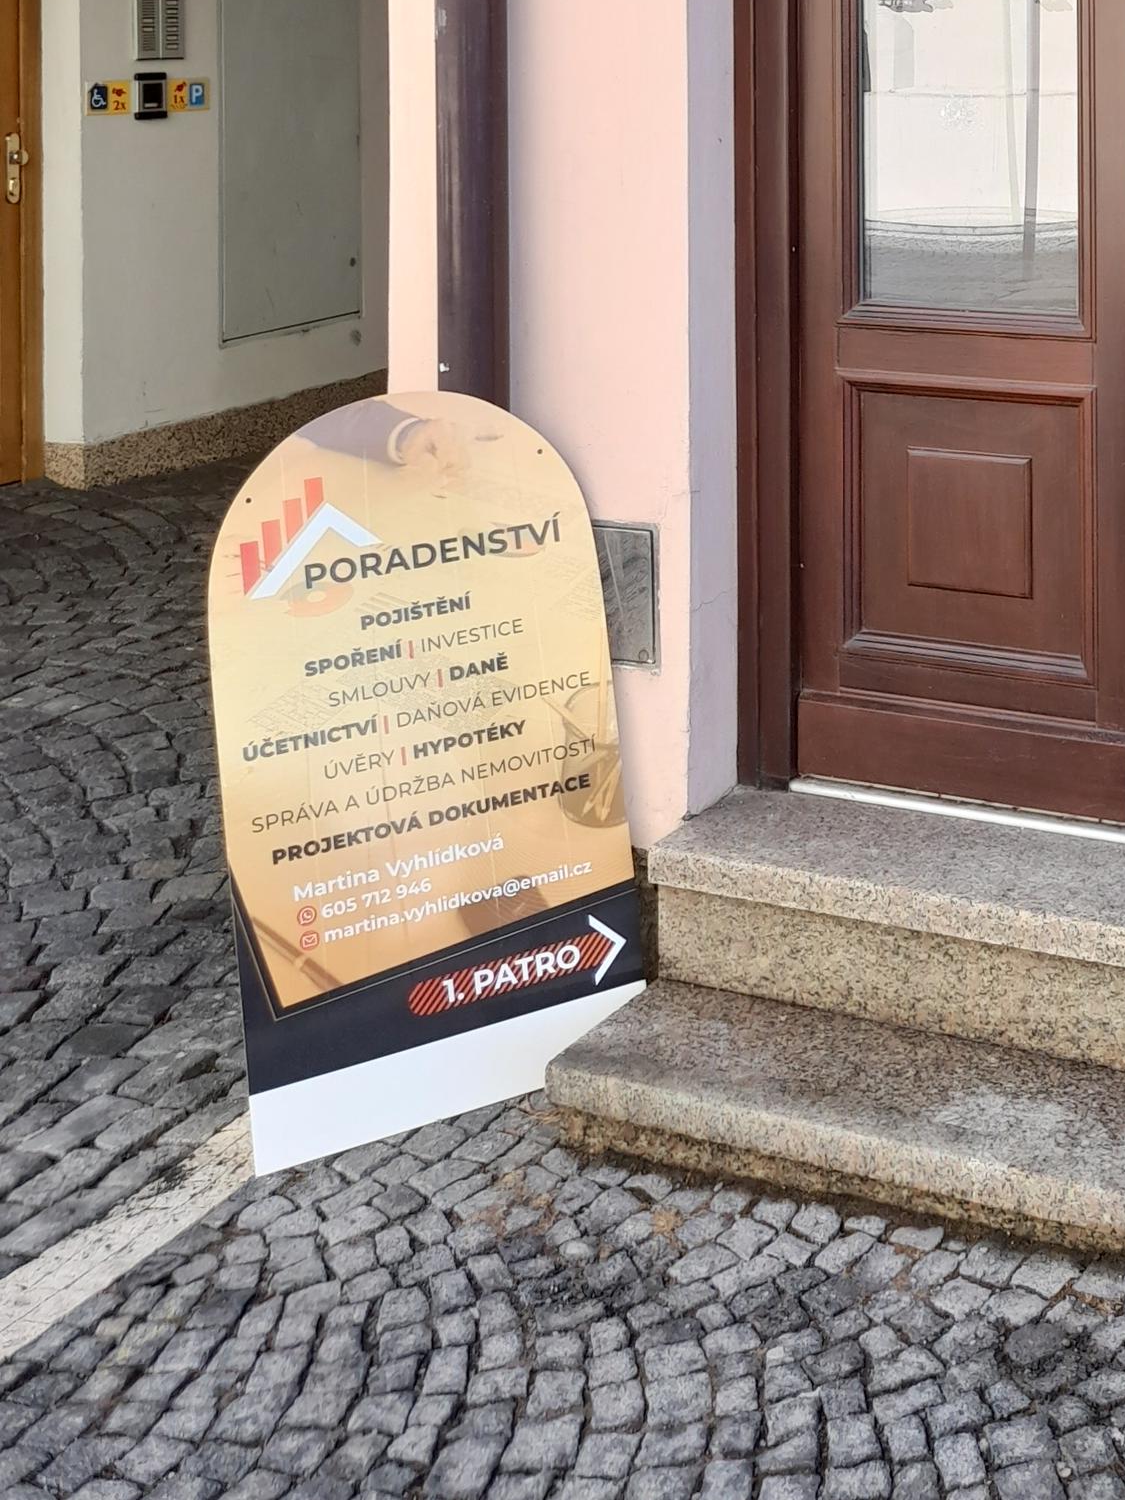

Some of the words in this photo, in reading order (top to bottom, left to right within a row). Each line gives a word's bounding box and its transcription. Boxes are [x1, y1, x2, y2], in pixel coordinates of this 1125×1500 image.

[304, 511, 562, 590] PORADENSTVÍ
[360, 591, 472, 631] POJIŠTĚNÍ
[304, 639, 403, 678] SPOŘENÍ
[420, 618, 524, 654] INVESTICE
[328, 671, 431, 708] SMLOUVY
[449, 652, 510, 682] DANĚ
[242, 714, 378, 763] ÚČETNICTVÍ
[396, 694, 486, 729] DAŇOVÁ
[491, 670, 592, 707] EVIDENCE
[323, 749, 396, 781] ÚVĚRY
[412, 719, 528, 760] HYPOTÉKY
[251, 801, 340, 834] SPRÁVA
[344, 793, 361, 812] A
[365, 771, 457, 806] ÚDRŽBA
[461, 733, 597, 784] NEMOVITOSTÍ
[271, 809, 424, 866] PROJEKTOVÁ
[428, 773, 592, 827] DOKUMENTACE
[293, 866, 381, 902] Martina
[385, 832, 505, 878] Vyhlídková
[321, 895, 359, 919] 605
[362, 887, 391, 908] 712
[396, 877, 433, 900] 946
[323, 859, 594, 945] martina.vyhlidkova@email.cz
[441, 975, 466, 1004] 1.
[473, 943, 582, 997] PATRO
